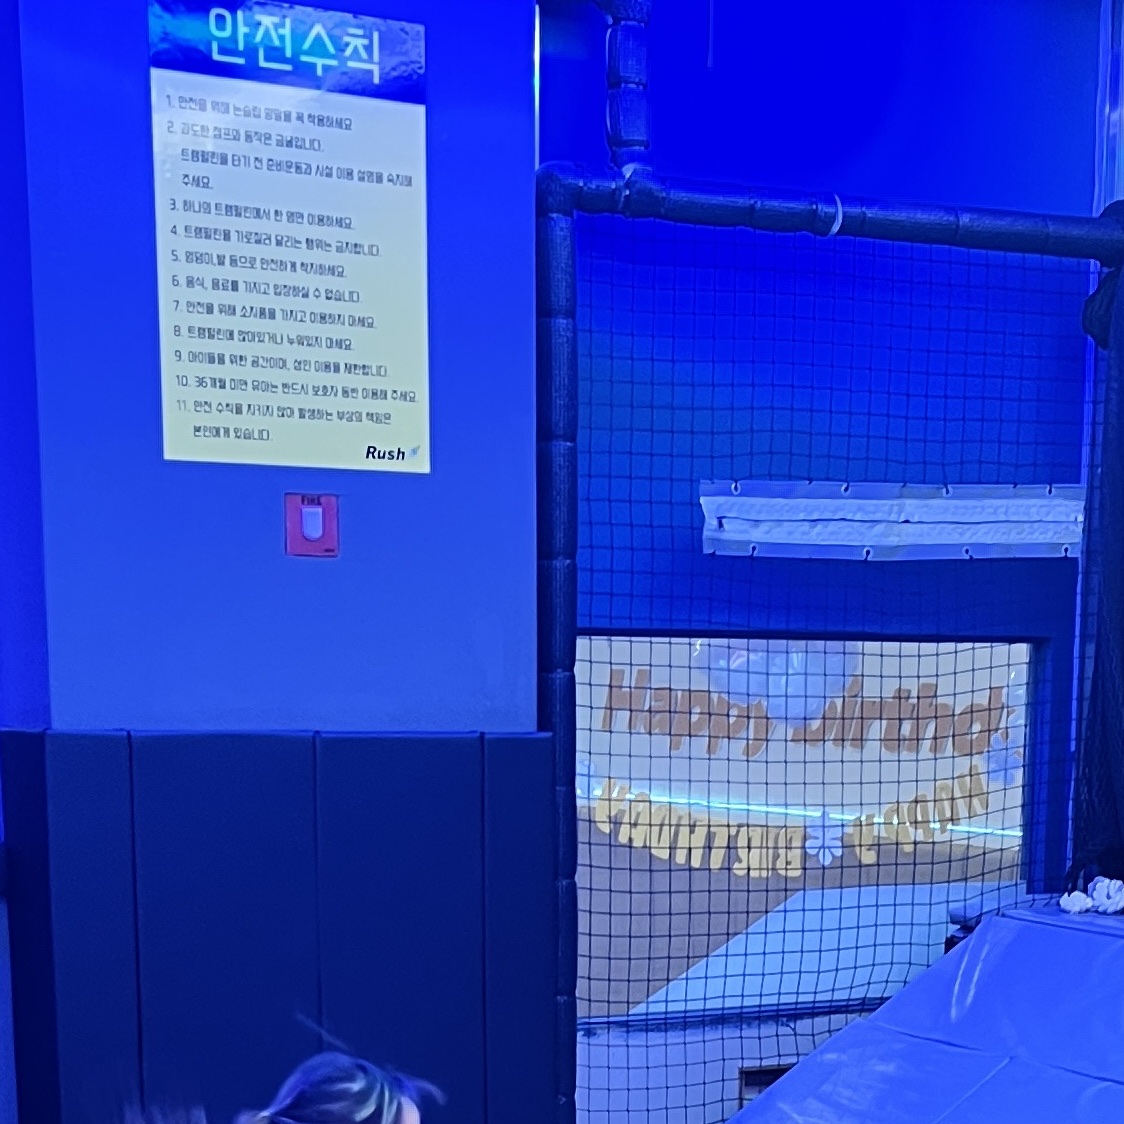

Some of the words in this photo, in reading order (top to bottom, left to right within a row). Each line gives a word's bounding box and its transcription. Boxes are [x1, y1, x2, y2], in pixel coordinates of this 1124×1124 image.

[209, 7, 380, 84] 안전수칙
[166, 94, 176, 109] 1.
[178, 96, 207, 112] 안전을
[211, 100, 230, 114] 위해
[167, 120, 177, 135] 2.
[231, 153, 251, 168] 타기
[253, 156, 264, 170] 전
[315, 164, 334, 179] 시설
[336, 166, 354, 181] 이용
[169, 198, 180, 212] 3.
[183, 199, 212, 215] 하나의
[274, 209, 283, 223] 한
[170, 224, 181, 237] 4.
[235, 230, 272, 246] 가로질러
[275, 234, 302, 250] 달리는
[305, 238, 332, 253] 행위는
[171, 249, 181, 263] 5.
[229, 254, 257, 270] 등으로
[171, 275, 182, 288] 6.
[212, 278, 239, 292] 음료를
[242, 280, 270, 295] 가지고
[312, 288, 322, 299] 수
[172, 300, 183, 312] 7.
[186, 301, 214, 315] 안전을
[217, 303, 236, 317] 위해
[240, 306, 276, 321] 소지품을
[280, 308, 307, 323] 가지고
[309, 311, 345, 326] 이용하지
[173, 325, 184, 338] 8.
[174, 349, 185, 363] 9.
[188, 350, 226, 365] 아이들을
[229, 354, 248, 367] 위한
[293, 359, 312, 372] 성인
[314, 361, 341, 374] 이용을
[175, 375, 192, 388] 10.
[194, 376, 226, 390] 36개월
[252, 380, 279, 394] 유아는
[281, 382, 309, 395] 반드시
[312, 384, 339, 398] 보호자
[341, 386, 359, 399] 동반
[176, 399, 191, 413] 11.
[193, 400, 212, 414] 안전
[216, 401, 243, 416] 수칙을
[247, 403, 274, 417] 지키지
[193, 425, 231, 439] 본인에게
[365, 445, 406, 461] Rush
[600, 669, 777, 758] Happy
